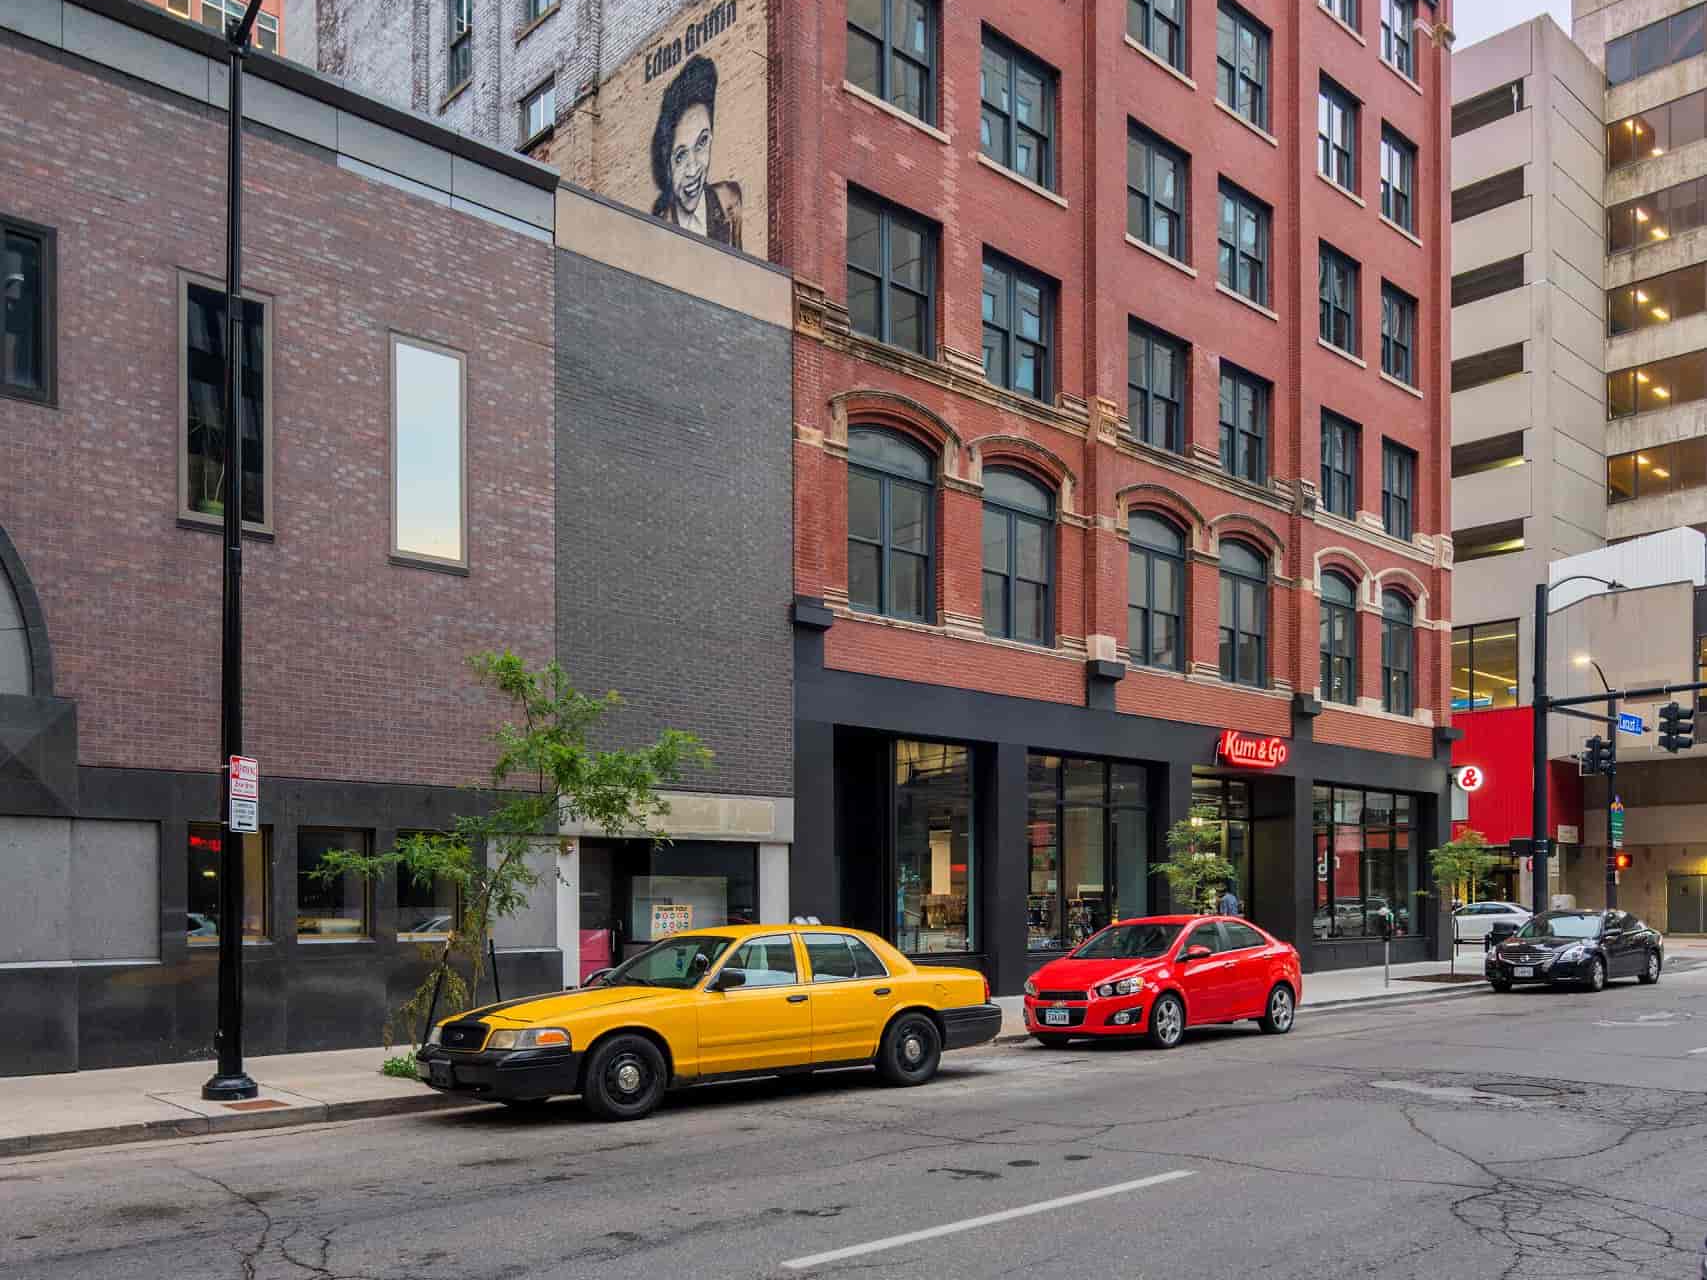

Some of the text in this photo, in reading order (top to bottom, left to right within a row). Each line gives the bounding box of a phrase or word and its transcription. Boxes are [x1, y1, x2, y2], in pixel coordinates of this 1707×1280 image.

[644, 0, 737, 84] Edna Griffin
[1224, 730, 1287, 765] Kum & Go
[1462, 768, 1477, 786] &
